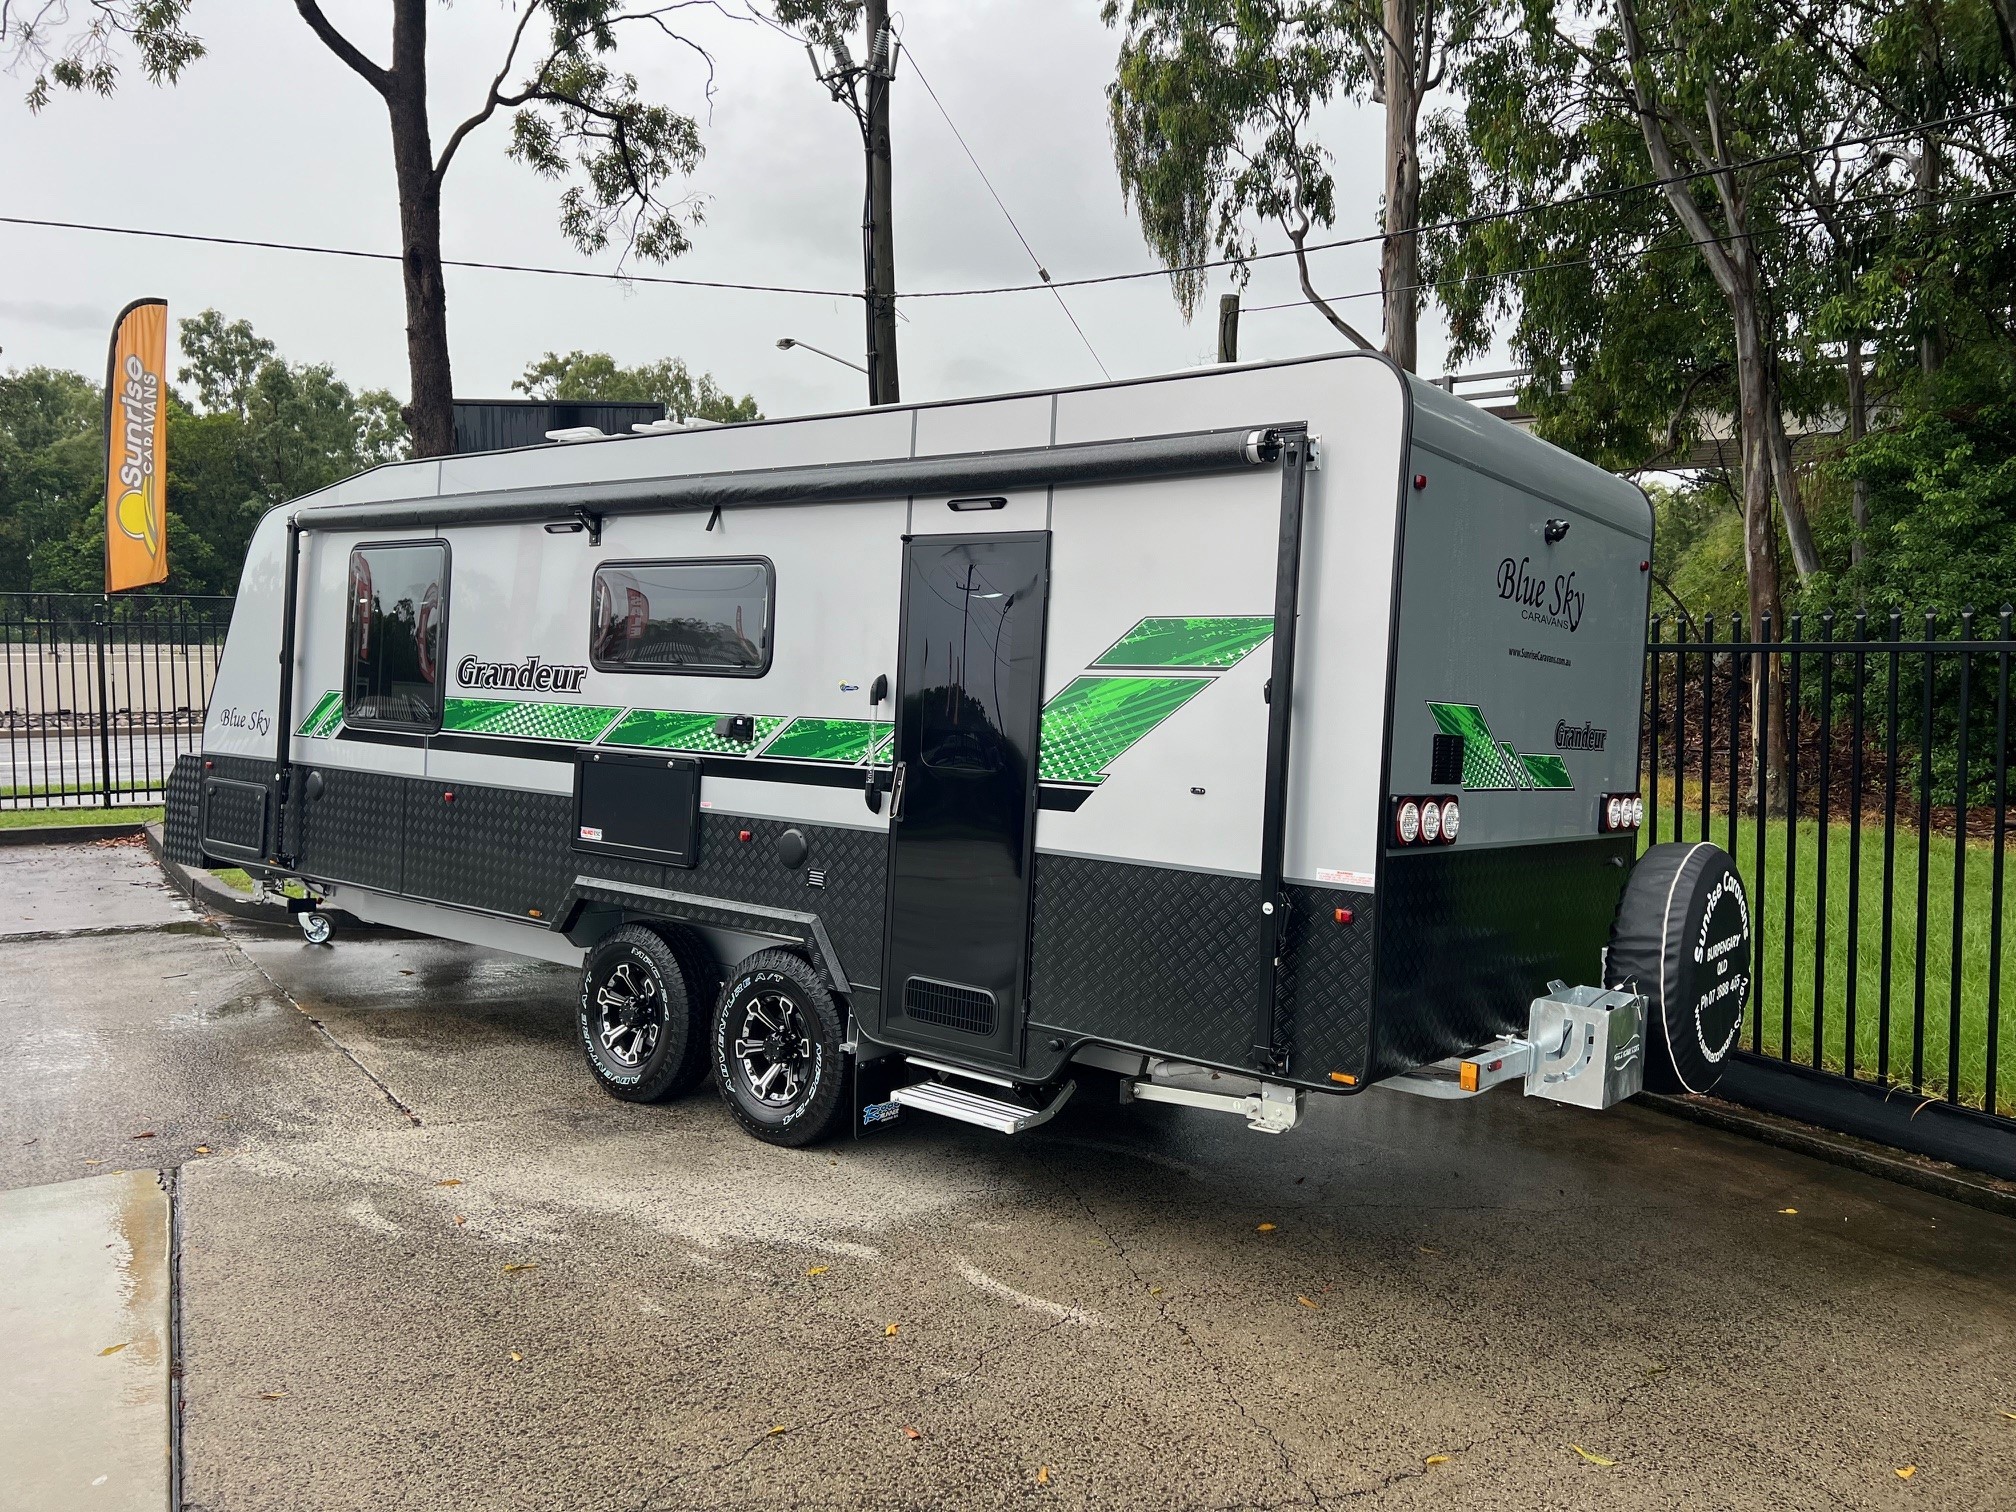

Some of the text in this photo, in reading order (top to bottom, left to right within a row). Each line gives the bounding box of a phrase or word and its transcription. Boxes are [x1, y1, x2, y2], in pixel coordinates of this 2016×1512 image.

[121, 355, 143, 488] Sunrise
[143, 373, 158, 475] CARAVANS
[1497, 556, 1585, 633] Blue Sky
[1521, 609, 1569, 630] CARAVANS
[455, 654, 589, 694] Grandeur
[1508, 647, 1572, 667] www.SunriseCaravans.com.au
[220, 706, 271, 737] Blue Sky
[1554, 718, 1608, 752] Grandeur
[1693, 870, 1749, 965] Sunrise Caravans
[1706, 933, 1742, 963] BURPENGARY
[1716, 958, 1728, 976] QLD
[1700, 993, 1709, 1012] Ph
[1708, 988, 1716, 1006] 07
[580, 1012, 642, 1086] ADVENTURE
[717, 972, 784, 1094] ADVENTURE A/T
